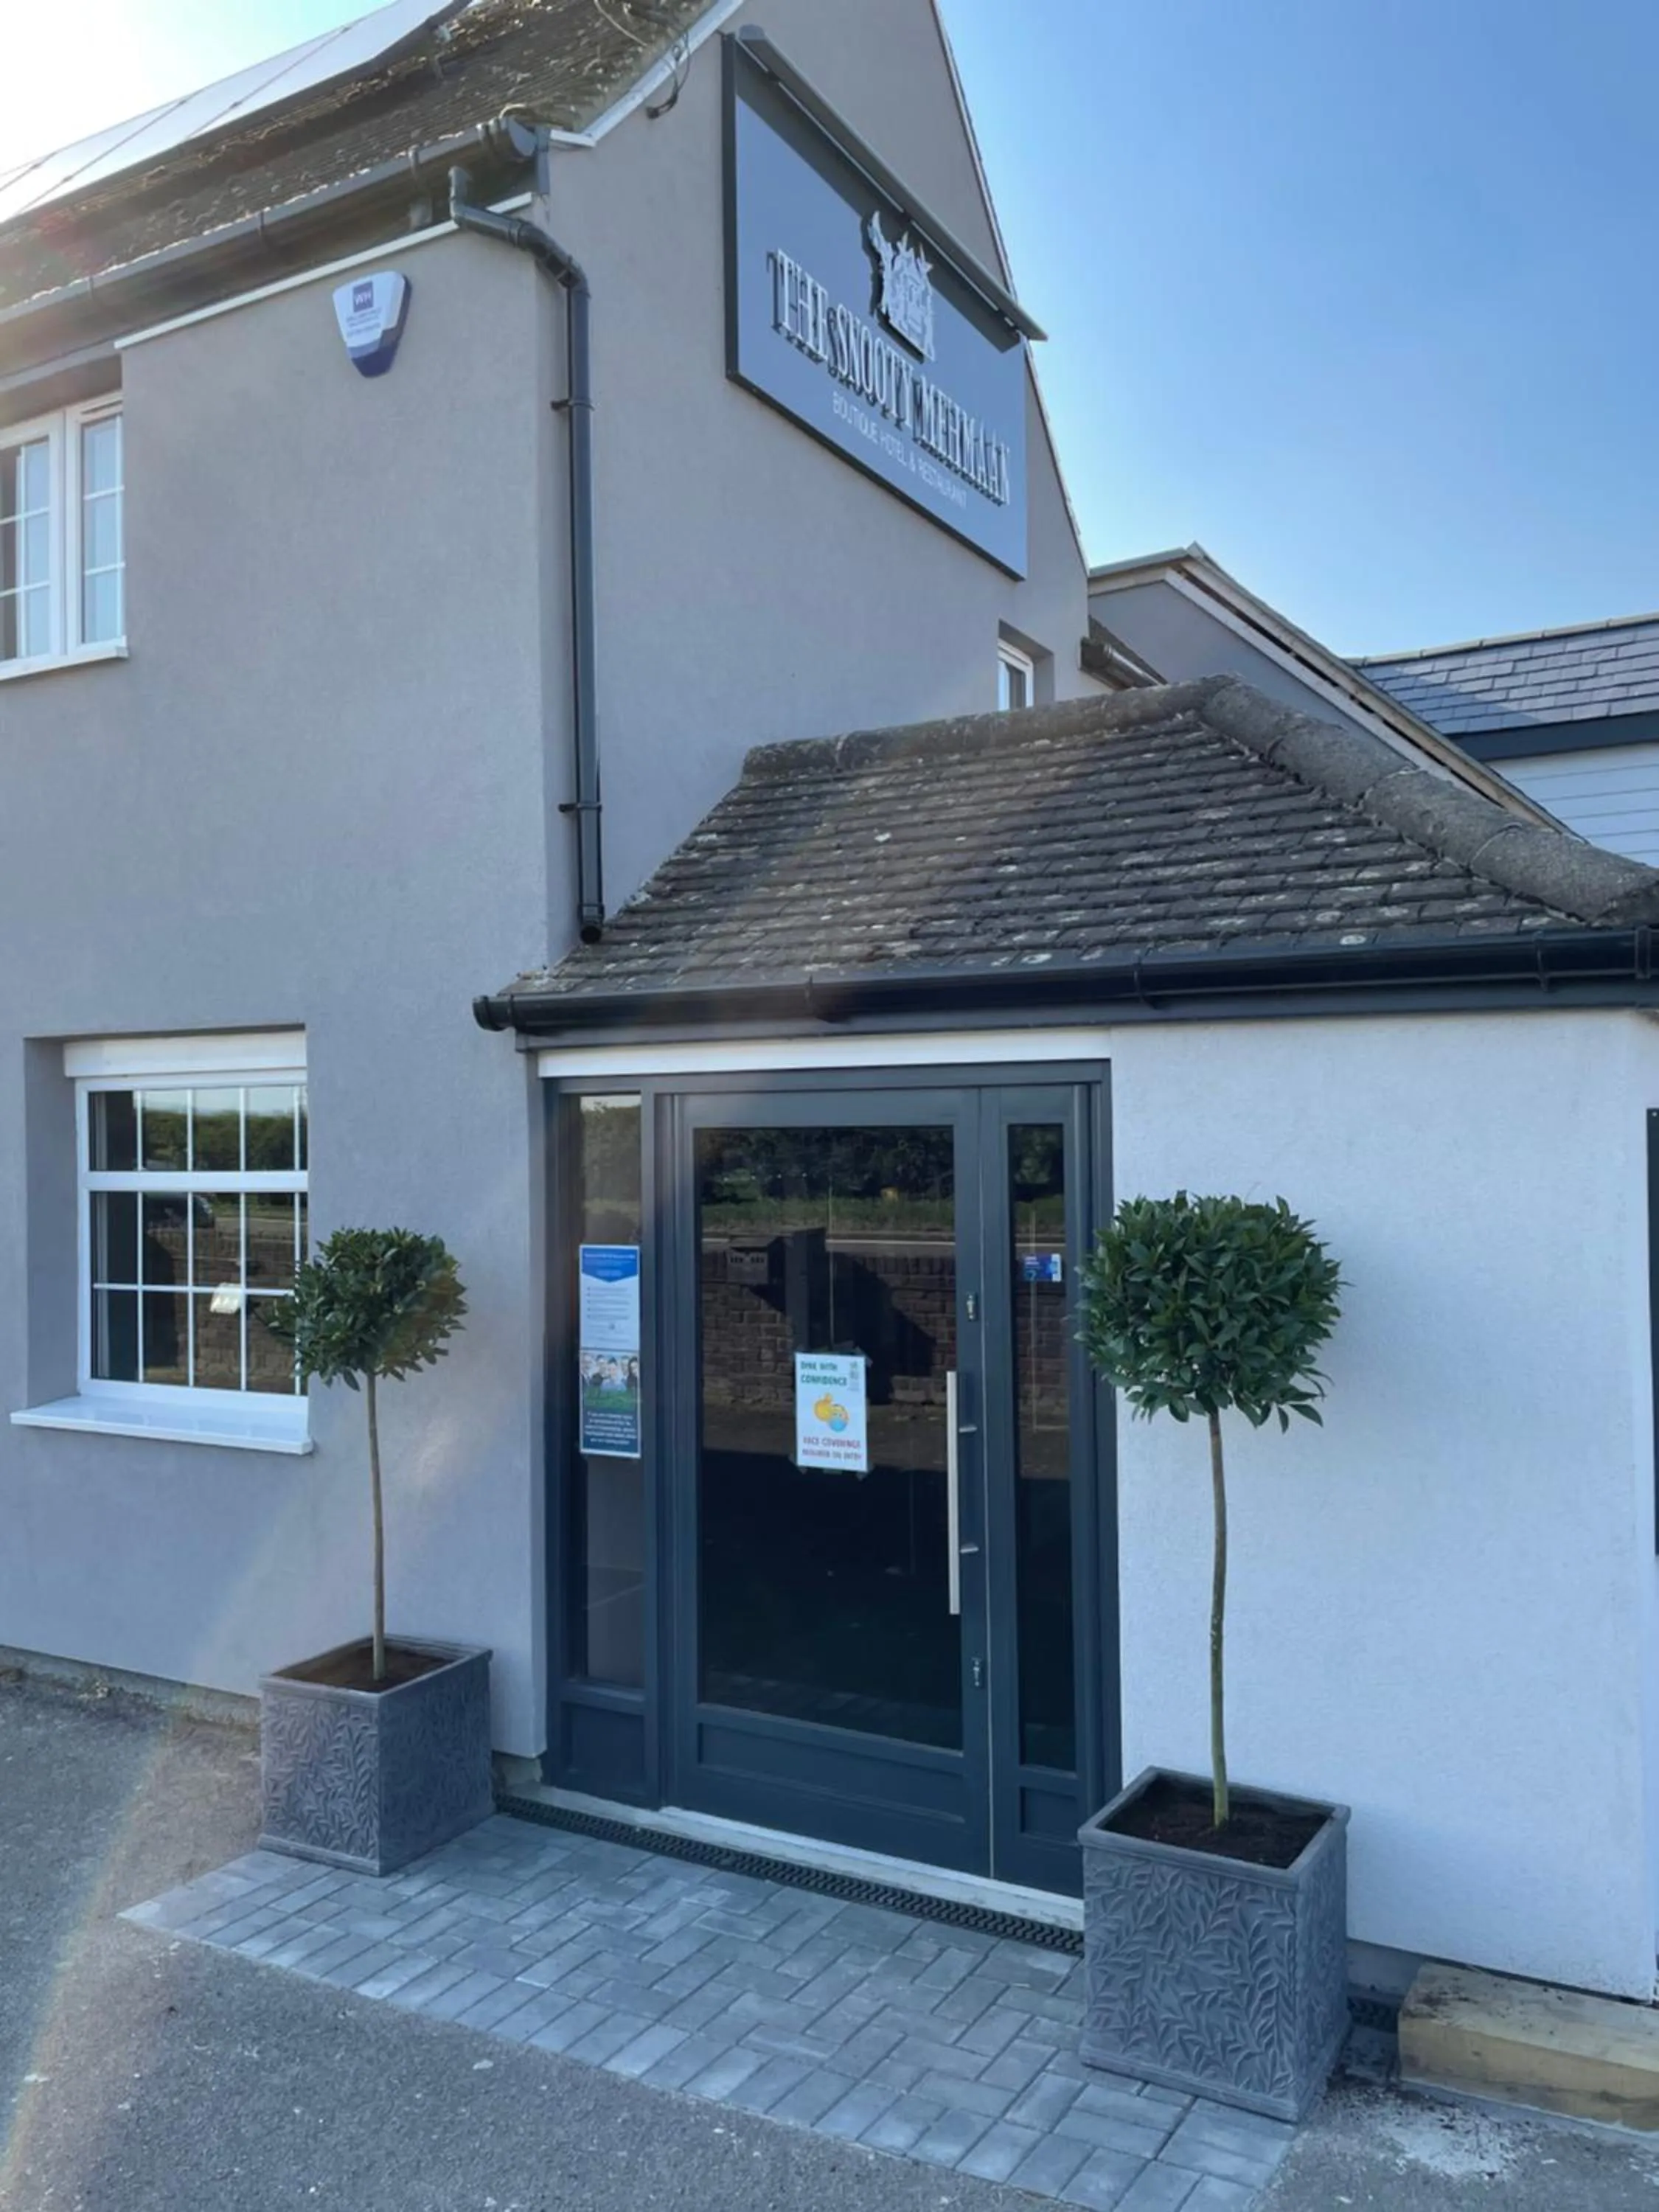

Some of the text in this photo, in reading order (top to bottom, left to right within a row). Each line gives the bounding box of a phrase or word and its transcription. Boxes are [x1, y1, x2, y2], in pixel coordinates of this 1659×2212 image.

[777, 248, 1010, 506] THE SNOOTY MEHMAAN
[832, 390, 878, 444] BOUTIQUE
[880, 428, 908, 467] HOTEL
[917, 456, 967, 509] RESTAURANT
[801, 1374, 847, 1386] CONFIDENCE
